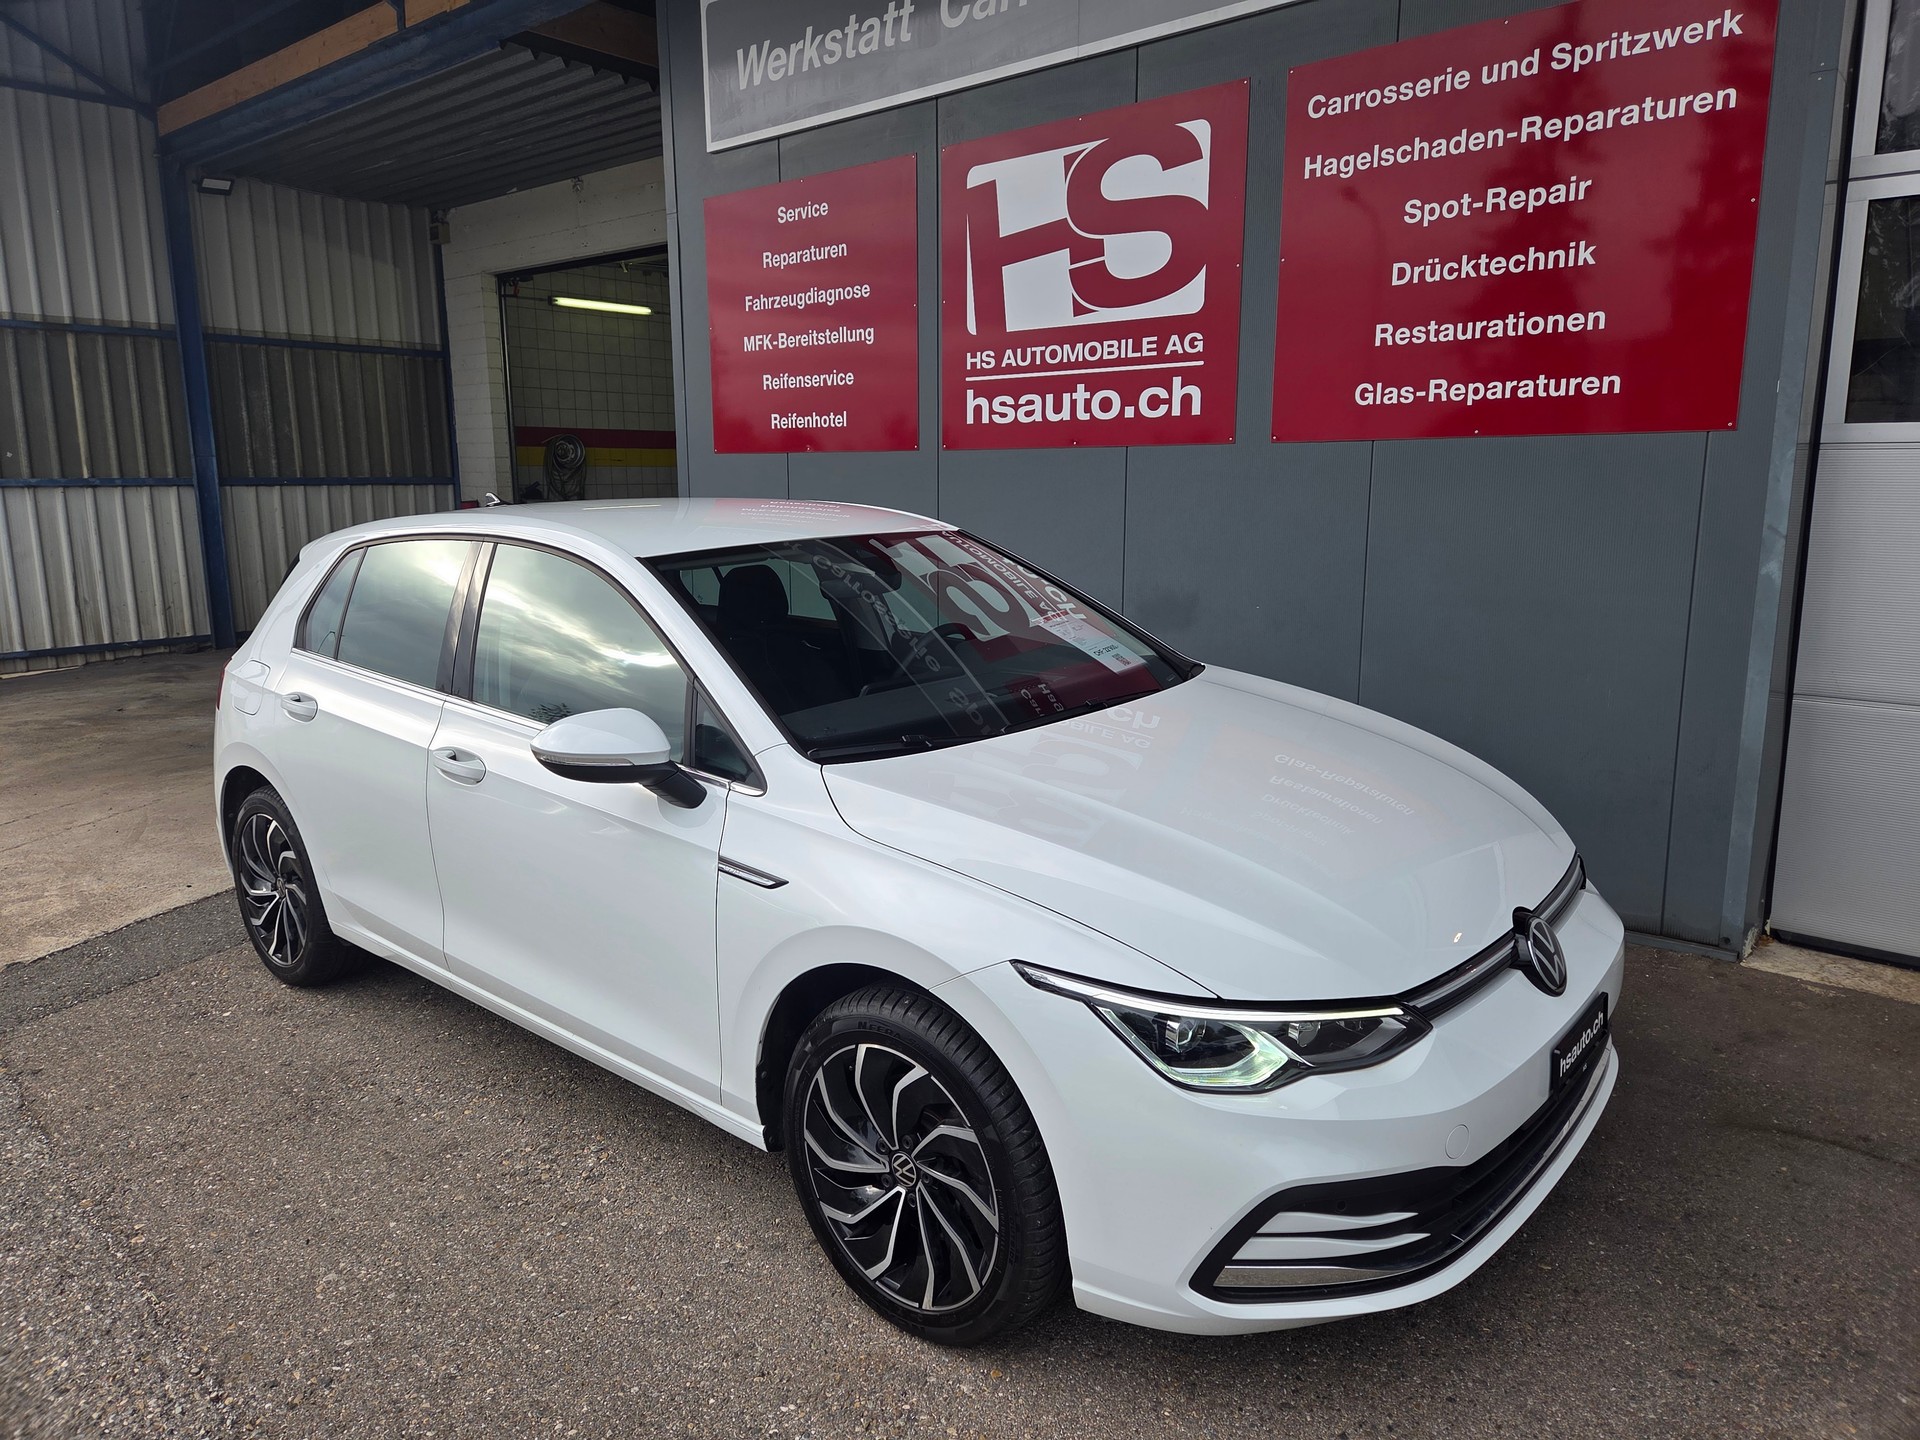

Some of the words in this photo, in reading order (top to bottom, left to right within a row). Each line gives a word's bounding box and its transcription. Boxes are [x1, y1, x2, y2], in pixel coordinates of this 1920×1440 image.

[735, 1, 915, 90] Werkstatt
[1307, 66, 1471, 119] Carrosserie
[1481, 48, 1540, 84] und
[1550, 8, 1744, 73] Spritzwerk
[1303, 86, 1738, 180] Hagelschaden-Reparaturen
[777, 201, 829, 224] Service
[1403, 175, 1593, 228] Spot-Repair
[762, 241, 847, 269] Reparaturen
[1391, 240, 1597, 286] Drücktechnik
[744, 282, 871, 312] Fahrzeugdiagnose
[743, 324, 874, 352] MFK-Bereitstellung
[1374, 309, 1606, 347] Restaurationen
[966, 350, 996, 370] HS
[1001, 338, 1158, 368] AUTOMOBILE
[1164, 332, 1204, 355] AG
[762, 369, 855, 390] Reifenservice
[1354, 372, 1621, 406] Glas-Reparaturen
[965, 376, 1202, 425] hsauto.ch
[770, 410, 847, 430] Reifenhotel
[1559, 1010, 1605, 1078] hsauto.ch
